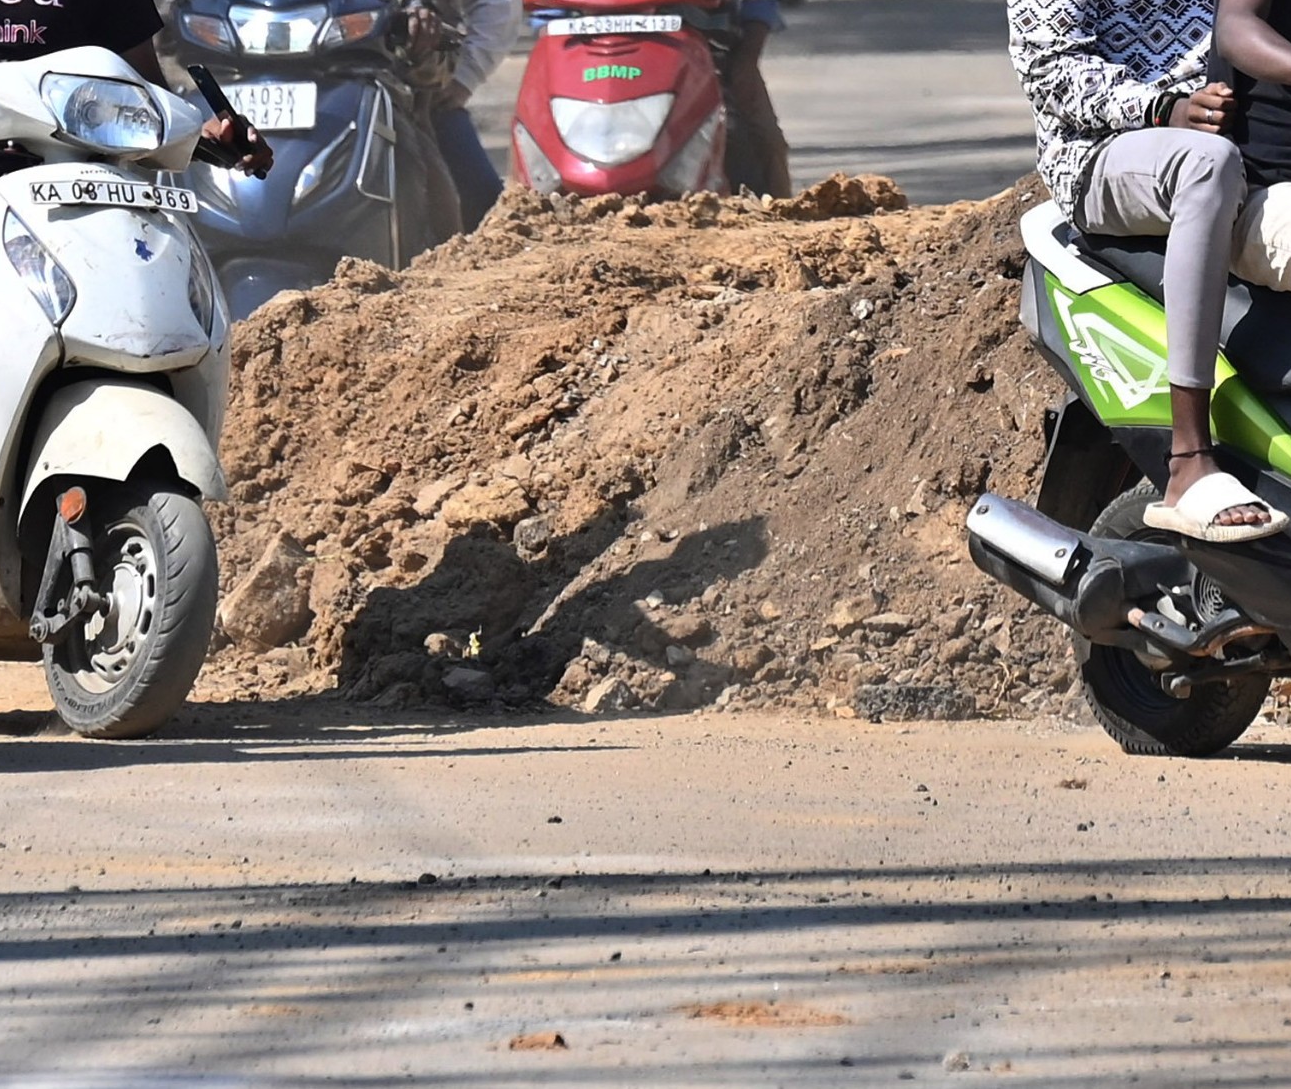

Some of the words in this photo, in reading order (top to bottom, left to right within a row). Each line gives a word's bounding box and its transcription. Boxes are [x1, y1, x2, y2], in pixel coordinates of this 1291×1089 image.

[583, 65, 643, 82] BBMP
[32, 184, 62, 202] KA
[107, 184, 135, 204] HU
[152, 187, 190, 210] 969
